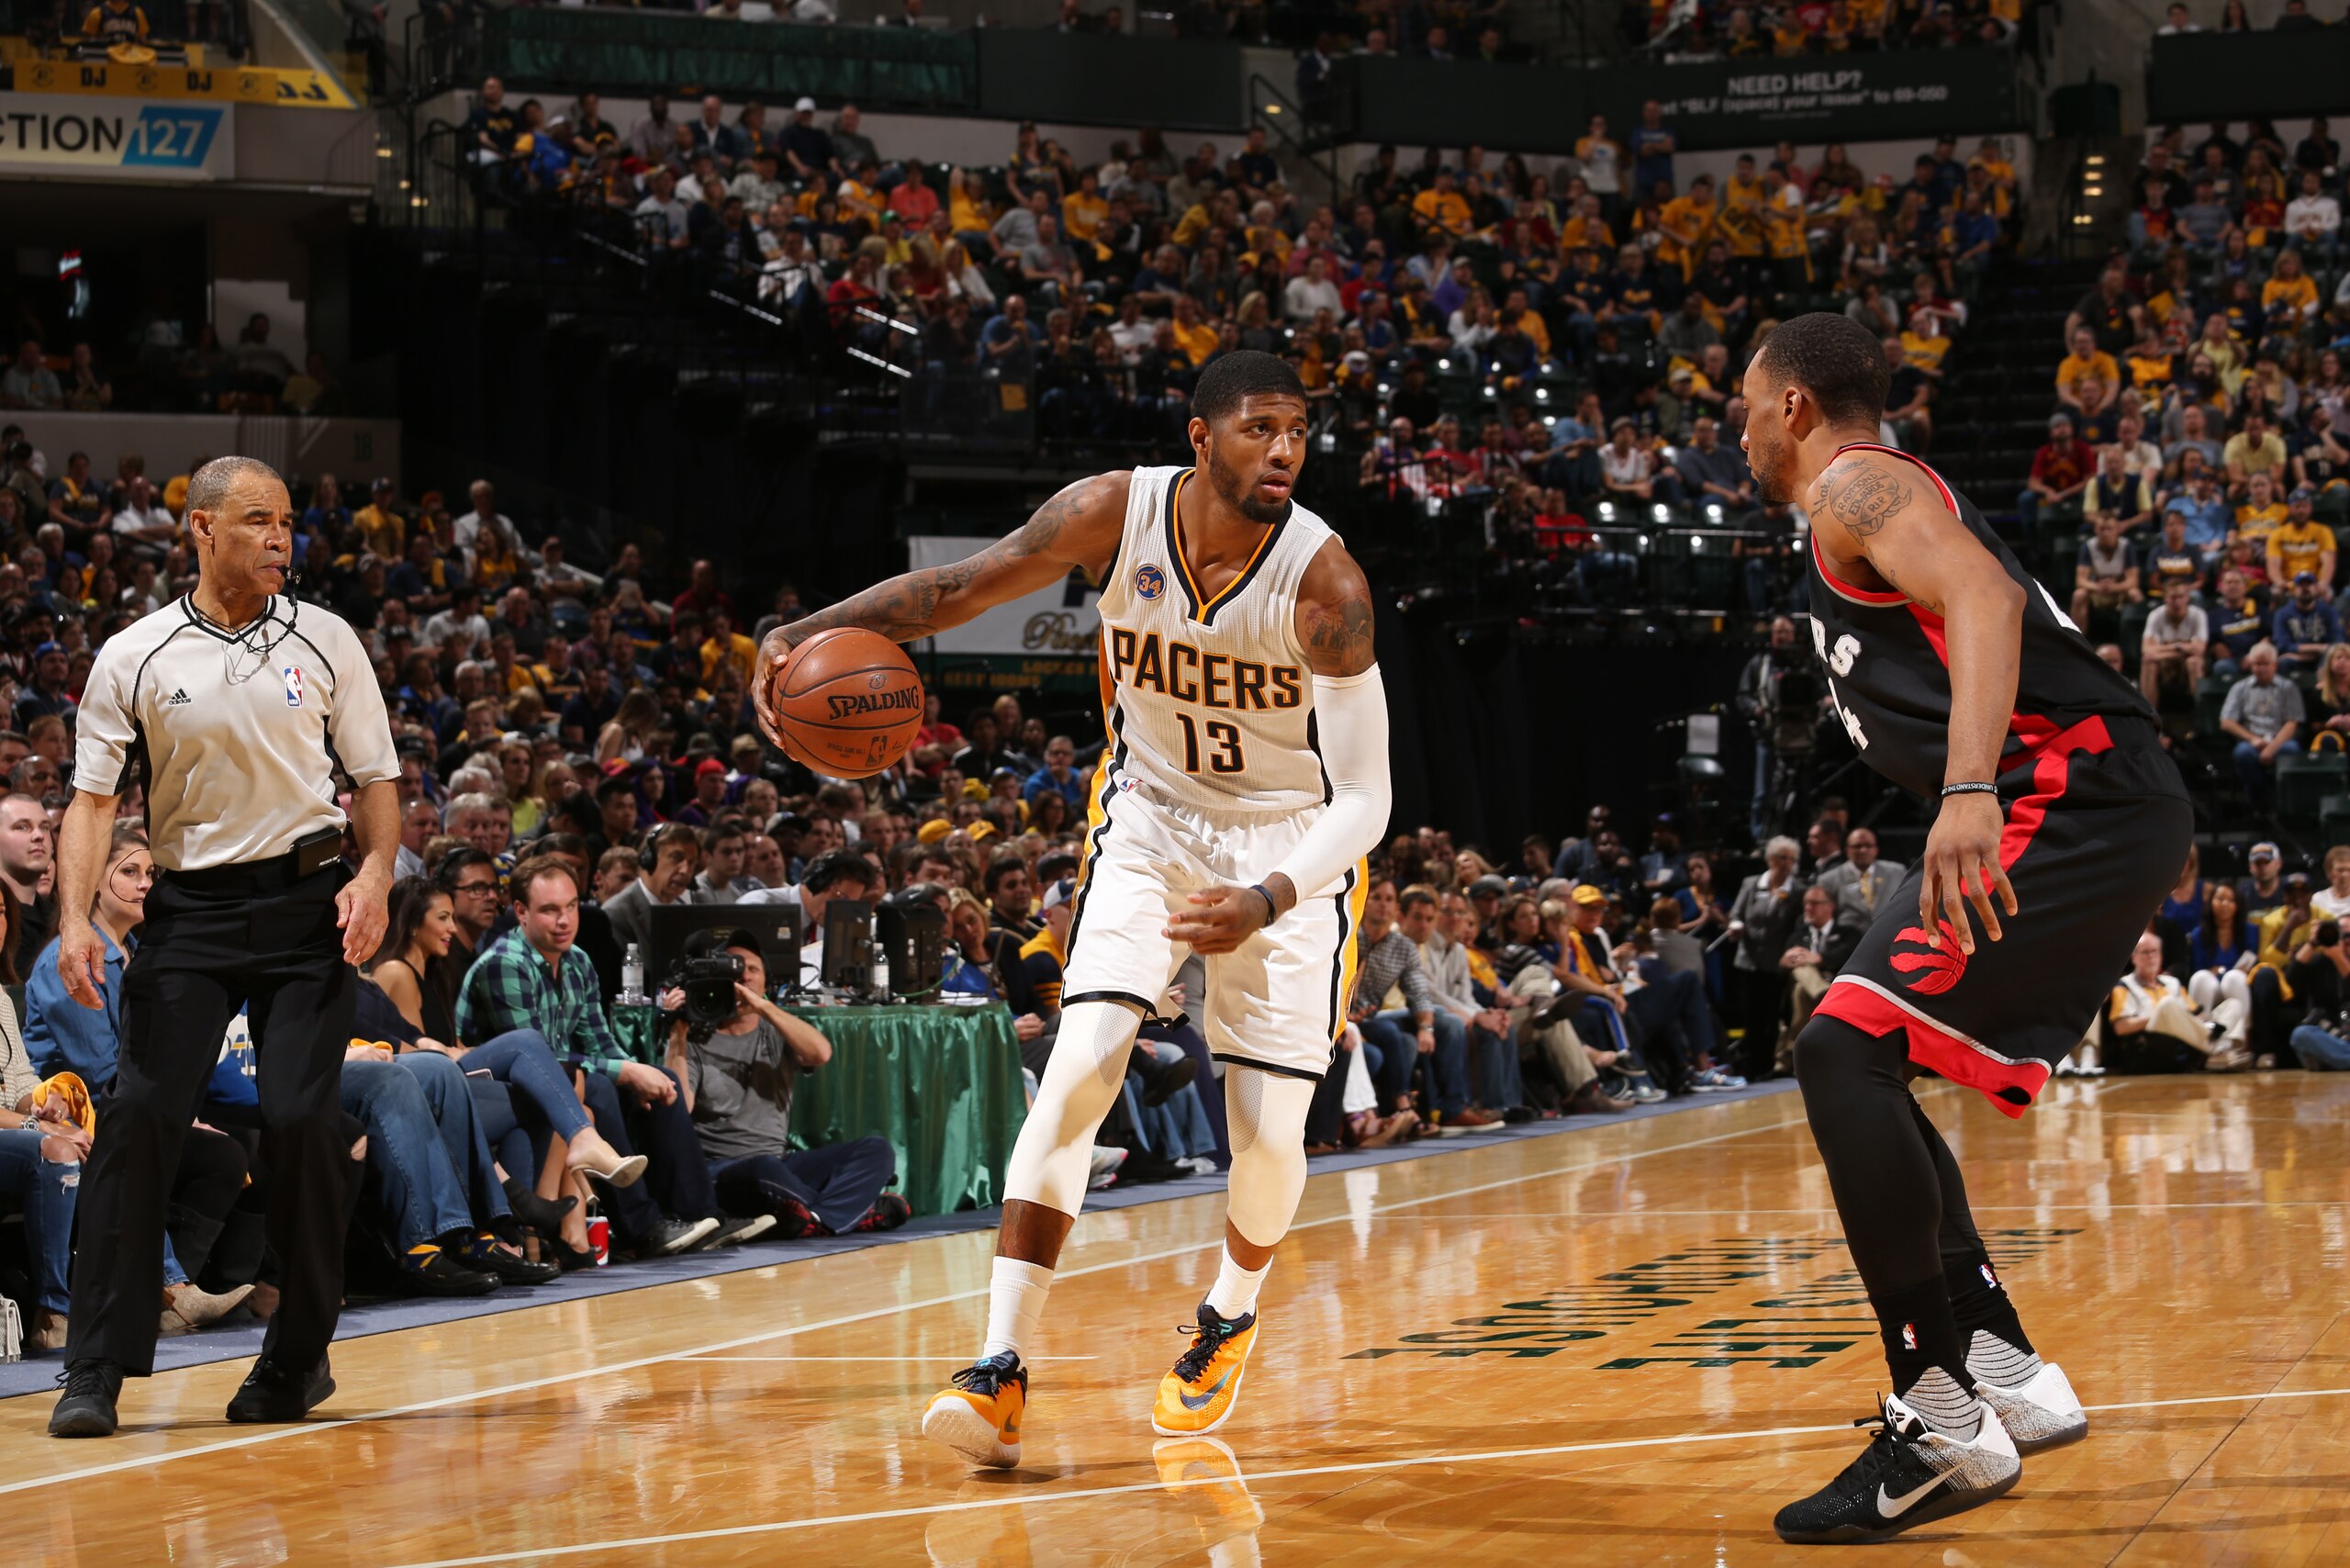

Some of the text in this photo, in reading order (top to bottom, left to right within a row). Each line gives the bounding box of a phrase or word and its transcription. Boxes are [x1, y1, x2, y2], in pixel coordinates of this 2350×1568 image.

[81, 67, 212, 92] DJ DJ
[1727, 70, 1863, 95] NEED HELP?
[135, 118, 205, 158] 127
[1837, 473, 1878, 511] RAYMOND
[1848, 481, 1886, 517] EDWARDS
[1138, 575, 1161, 596] 34
[1111, 626, 1304, 711] PACERS
[168, 697, 192, 706] adidas
[826, 685, 919, 721] SPALDING
[1175, 711, 1246, 774] 13
[1339, 1238, 1846, 1360] FIELDHOUSE
